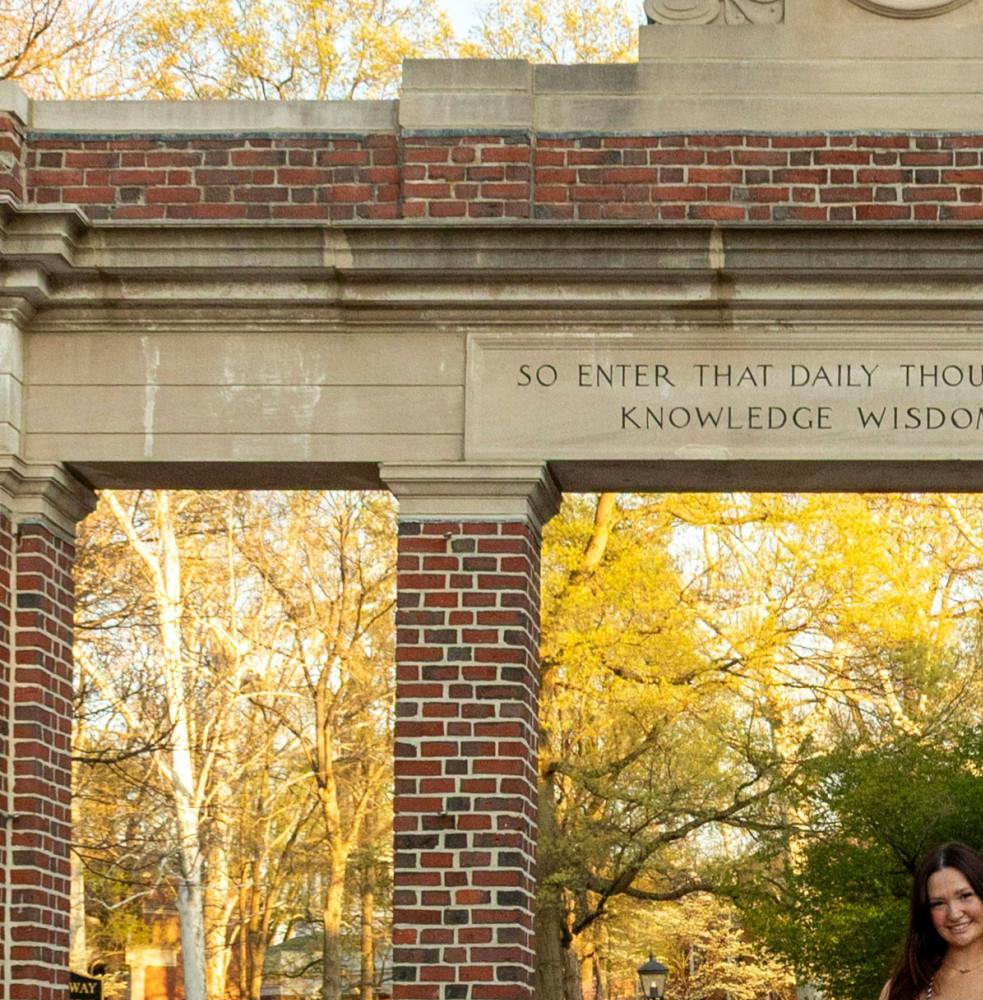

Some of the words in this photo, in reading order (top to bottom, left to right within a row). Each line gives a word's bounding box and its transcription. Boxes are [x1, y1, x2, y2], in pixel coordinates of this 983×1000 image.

[518, 364, 557, 387] SO
[579, 365, 675, 387] ENTER
[694, 364, 773, 387] THAT
[791, 365, 878, 387] DAILY
[900, 365, 983, 387] THOU
[622, 407, 832, 430] KNOWLEDGE
